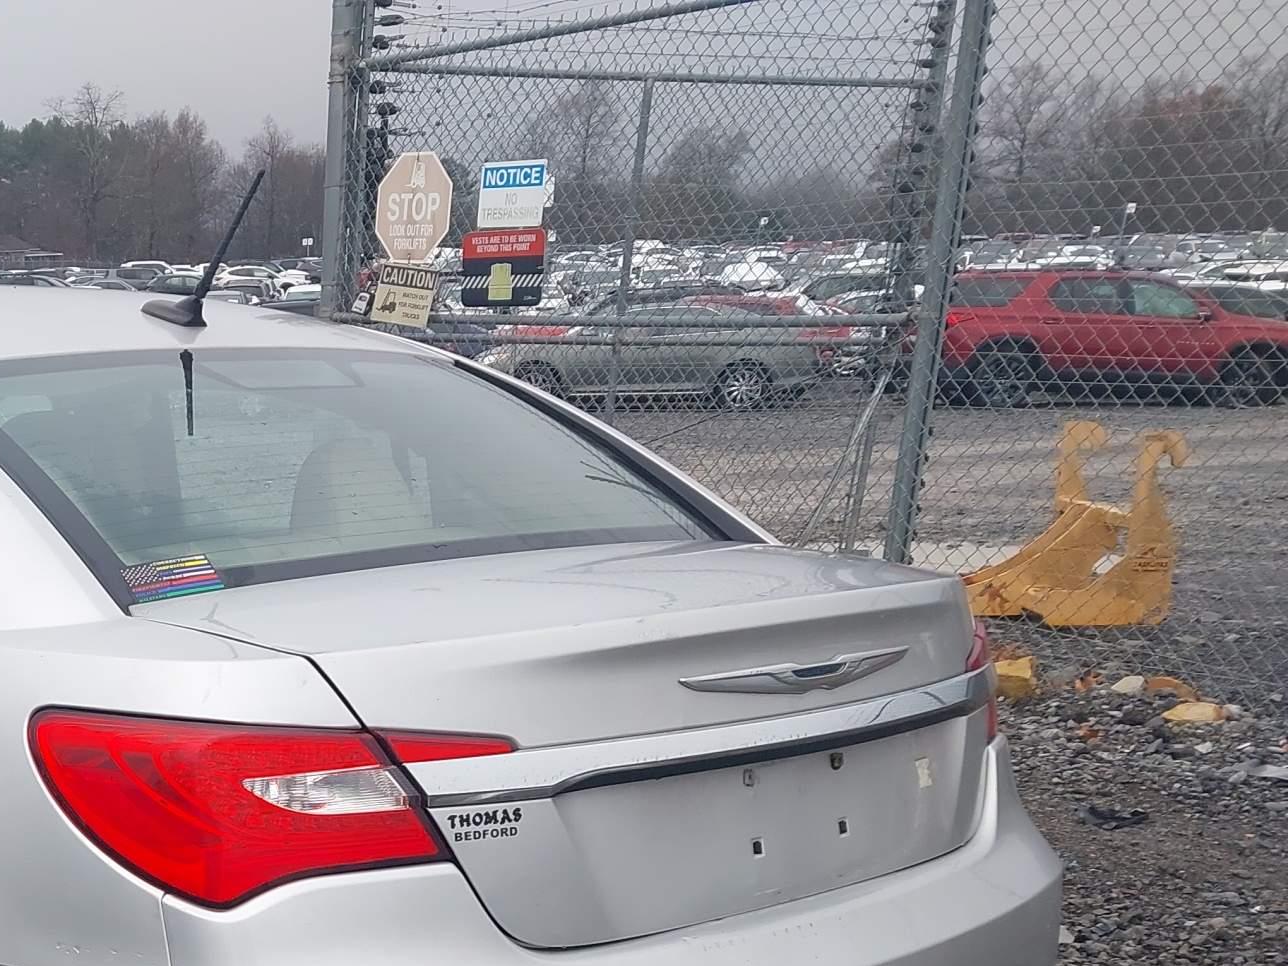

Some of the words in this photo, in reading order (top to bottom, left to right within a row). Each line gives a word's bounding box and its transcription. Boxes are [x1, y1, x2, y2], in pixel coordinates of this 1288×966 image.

[485, 167, 541, 186] NOTICE
[504, 192, 519, 206] NO
[387, 192, 440, 221] STOP
[481, 207, 539, 221] TRESPASSING
[389, 224, 405, 236] LOOK
[406, 224, 419, 236] OUT
[420, 224, 433, 236] FOR
[393, 238, 427, 250] FORKLIFTS
[472, 236, 489, 245] VESTS
[489, 235, 501, 244] ARE
[501, 235, 509, 243] TO
[510, 235, 518, 243] BE
[518, 234, 537, 242] WORN
[477, 244, 500, 253] BEYOND
[500, 243, 512, 252] THIS
[513, 243, 530, 251] POINT
[383, 266, 436, 289] CAUTION
[447, 807, 523, 829] THOMAS
[454, 826, 518, 842] BEDFORD
